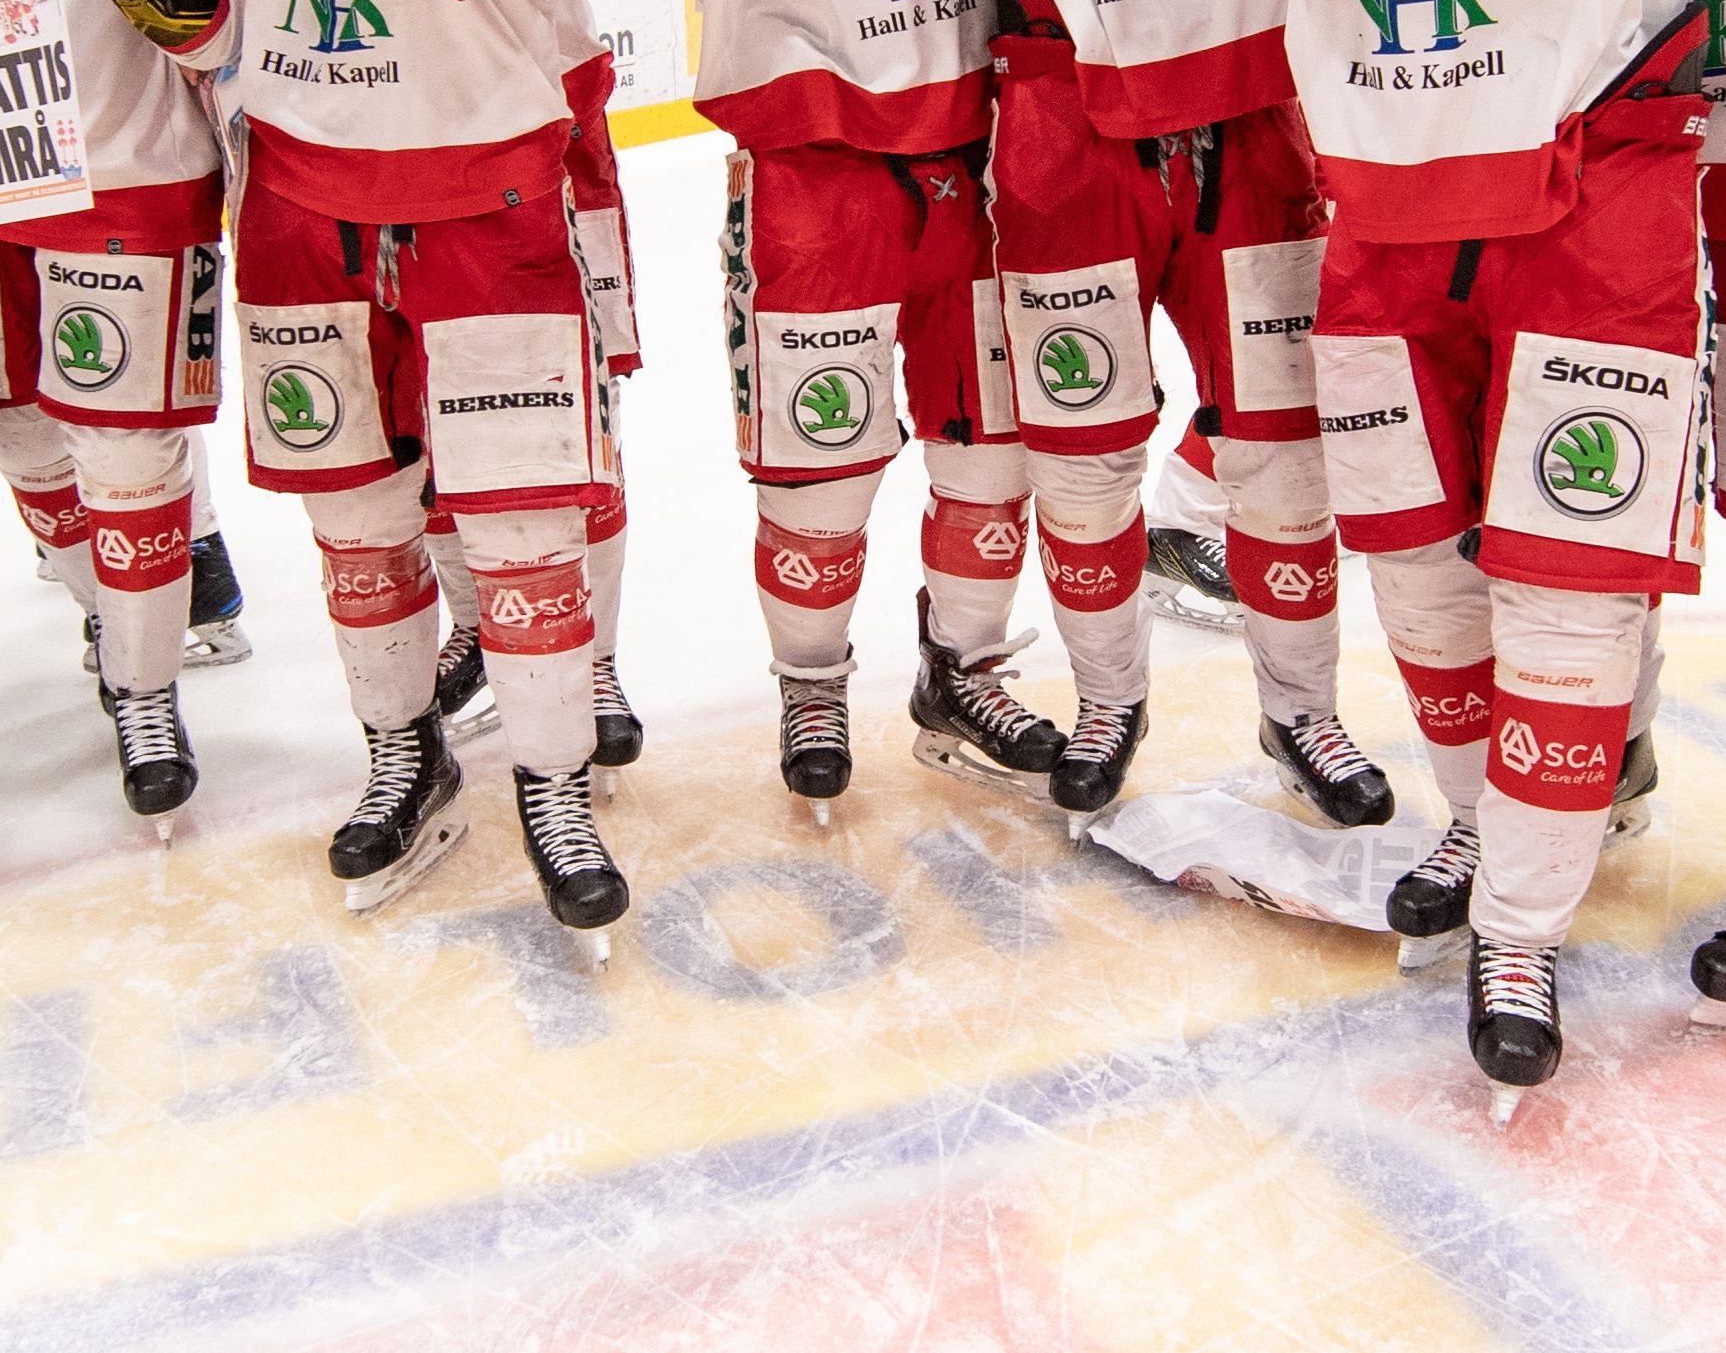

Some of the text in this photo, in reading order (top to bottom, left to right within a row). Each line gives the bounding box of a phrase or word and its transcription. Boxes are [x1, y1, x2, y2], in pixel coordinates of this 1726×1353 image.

[858, 7, 906, 40] Hall
[913, 3, 927, 26] &
[261, 50, 400, 88] Hall Kapell
[1393, 66, 1414, 91] &
[1421, 50, 1506, 91] Kapell
[47, 258, 144, 292] ŠKODA
[1019, 283, 1115, 312] ŠKODA
[250, 322, 343, 345] ŠKODA
[780, 327, 878, 350] ŠKODA
[1542, 356, 1670, 400] ŠKODA
[438, 391, 574, 415] BERNERS
[138, 527, 186, 557] SCA
[819, 548, 866, 582] SCA
[1060, 562, 1117, 584] SCA
[338, 572, 397, 596] SCA
[538, 589, 590, 617] SCA
[1420, 691, 1486, 716] SCA
[1543, 743, 1608, 768] SCA
